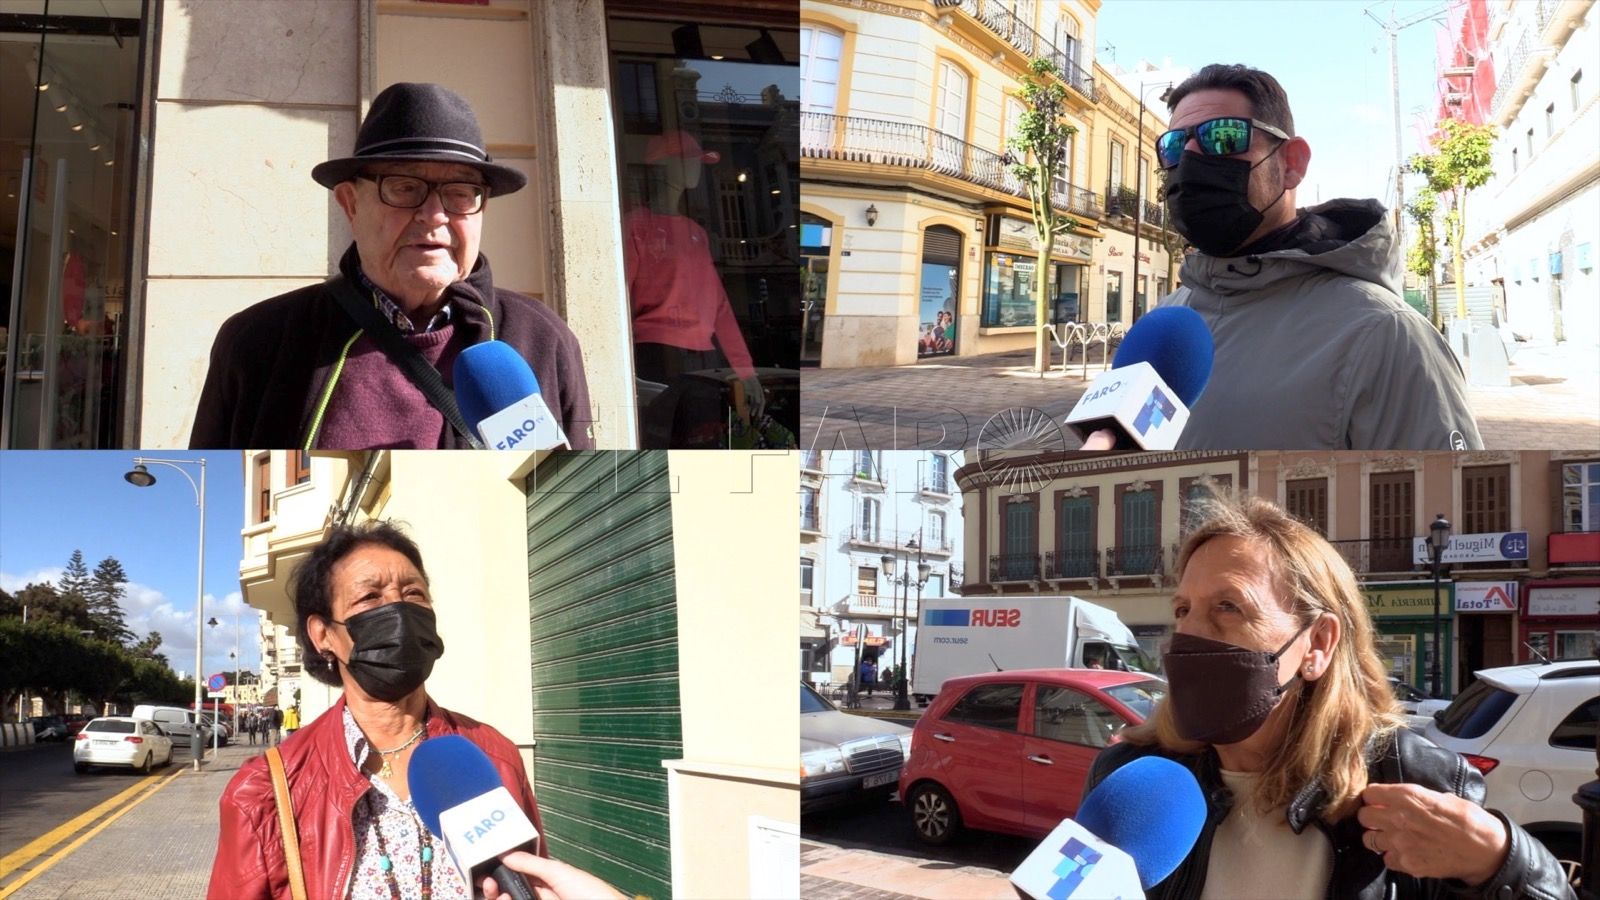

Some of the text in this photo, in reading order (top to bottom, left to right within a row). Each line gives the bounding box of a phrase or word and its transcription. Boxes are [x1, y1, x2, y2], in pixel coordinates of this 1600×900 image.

[1081, 380, 1122, 406] FARO
[495, 418, 536, 450] FARO
[463, 809, 506, 845] FARO
